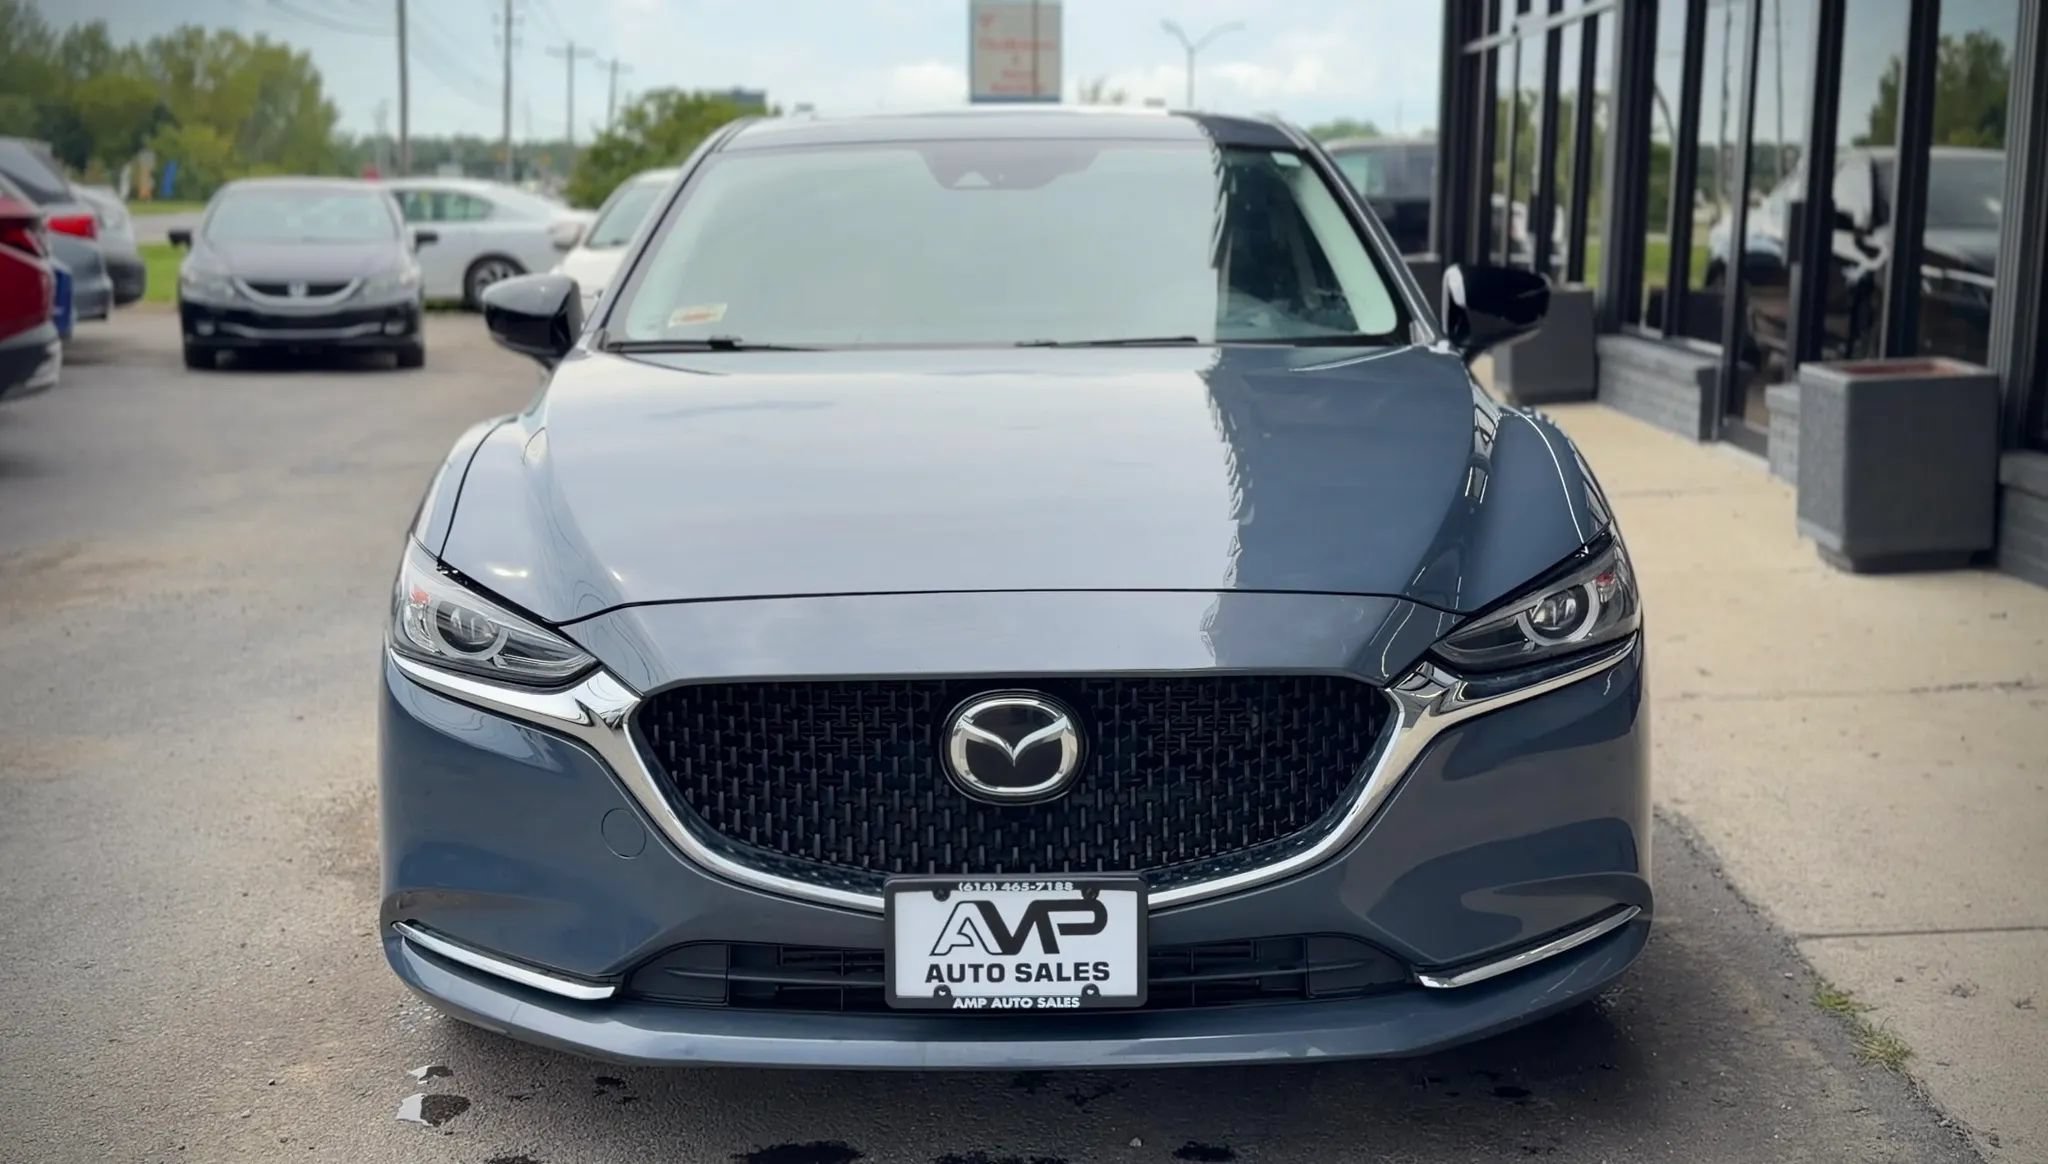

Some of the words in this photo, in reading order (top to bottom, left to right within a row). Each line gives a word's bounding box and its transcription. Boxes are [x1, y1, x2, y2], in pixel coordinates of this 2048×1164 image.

[925, 964, 1006, 983] AUTO
[1015, 962, 1110, 982] SALES
[953, 998, 987, 1008] AMP
[991, 998, 1033, 1008] AUTO
[1037, 998, 1080, 1008] SALES
